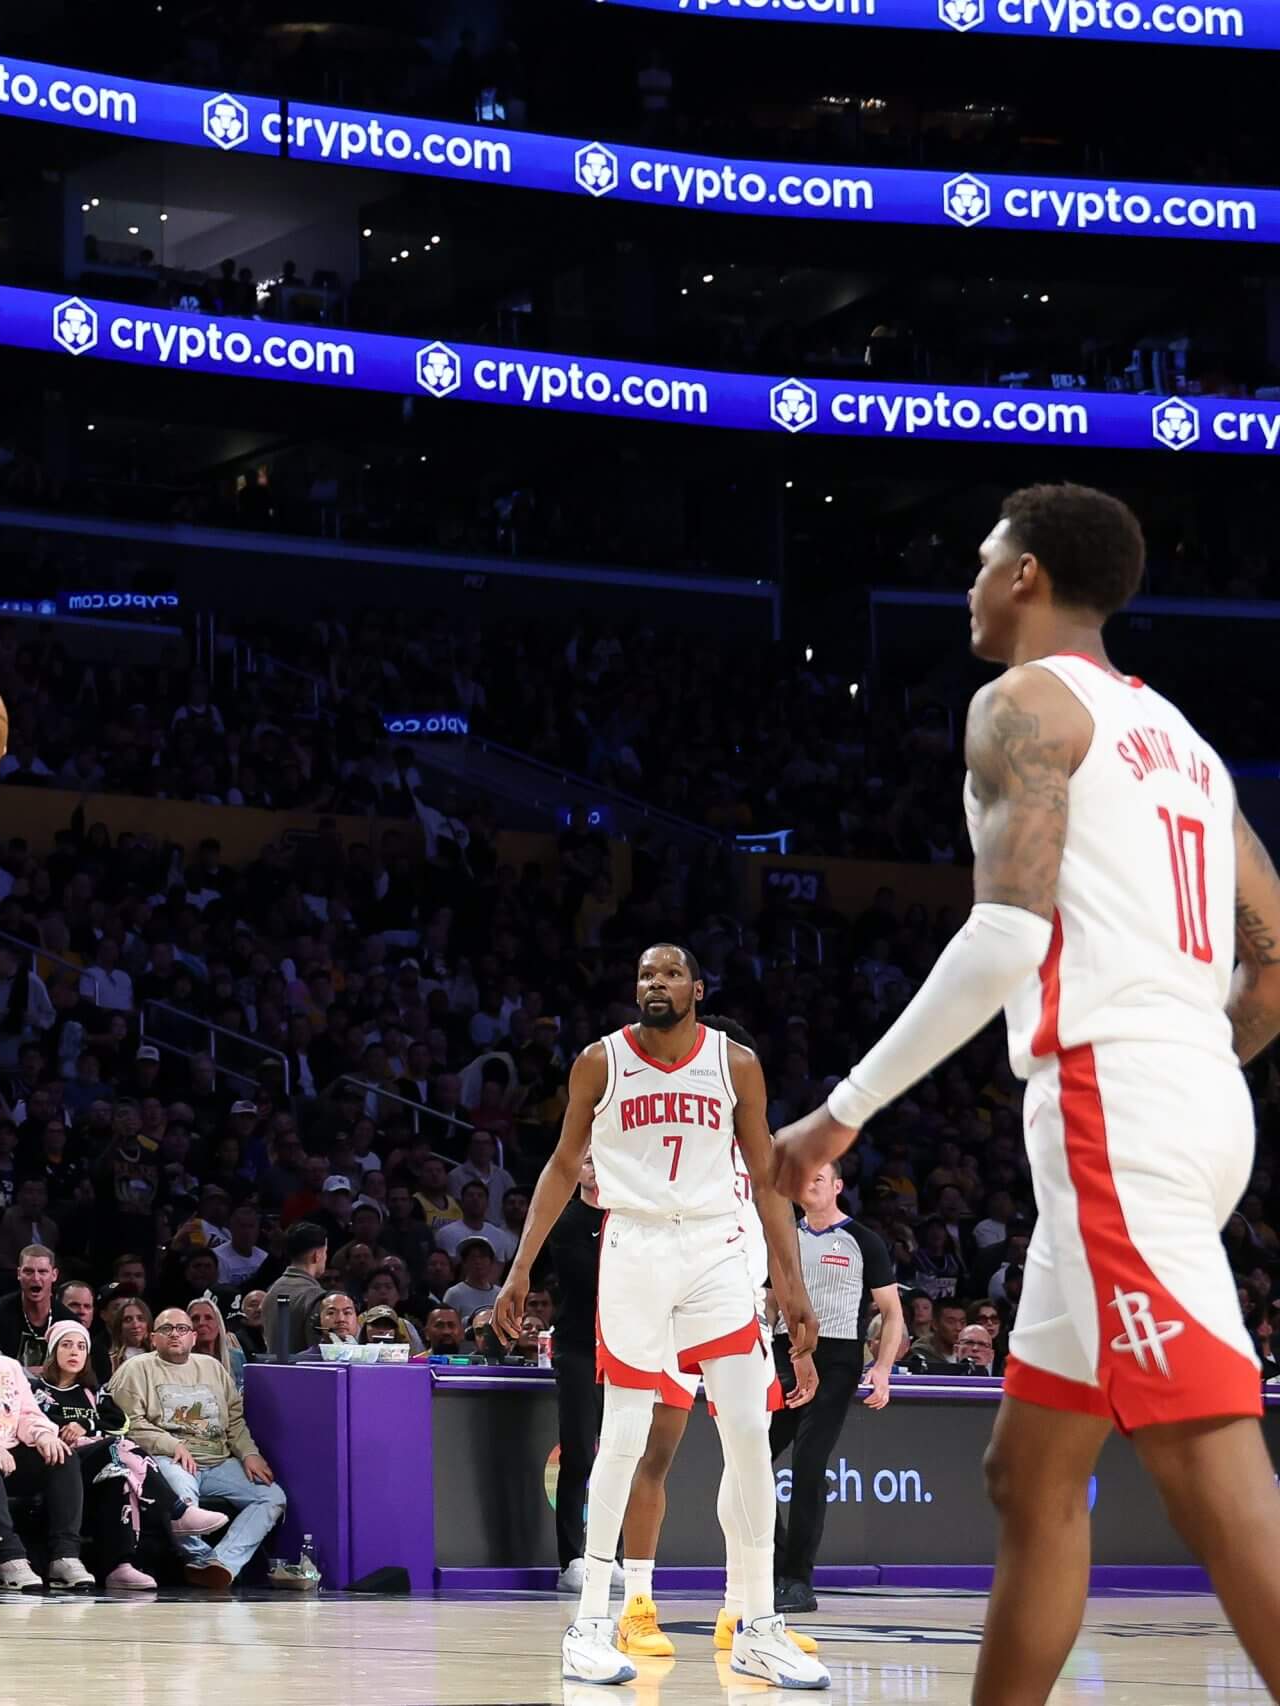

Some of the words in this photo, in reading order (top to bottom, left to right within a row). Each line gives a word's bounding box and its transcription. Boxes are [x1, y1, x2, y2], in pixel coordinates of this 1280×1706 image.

[998, 0, 1244, 36] crypto.com
[261, 111, 511, 172] crypto.com
[630, 159, 873, 209] crypto.com
[1004, 187, 1256, 229] crypto.com
[111, 315, 354, 375] crypto.com
[474, 358, 708, 413] crypto.com
[831, 391, 1087, 434] crypto.com
[1117, 727, 1180, 781] SMITH
[1157, 805, 1213, 964] 10
[620, 1093, 721, 1132] ROCKETS
[663, 1135, 682, 1182] 7
[874, 1469, 933, 1502] on.
